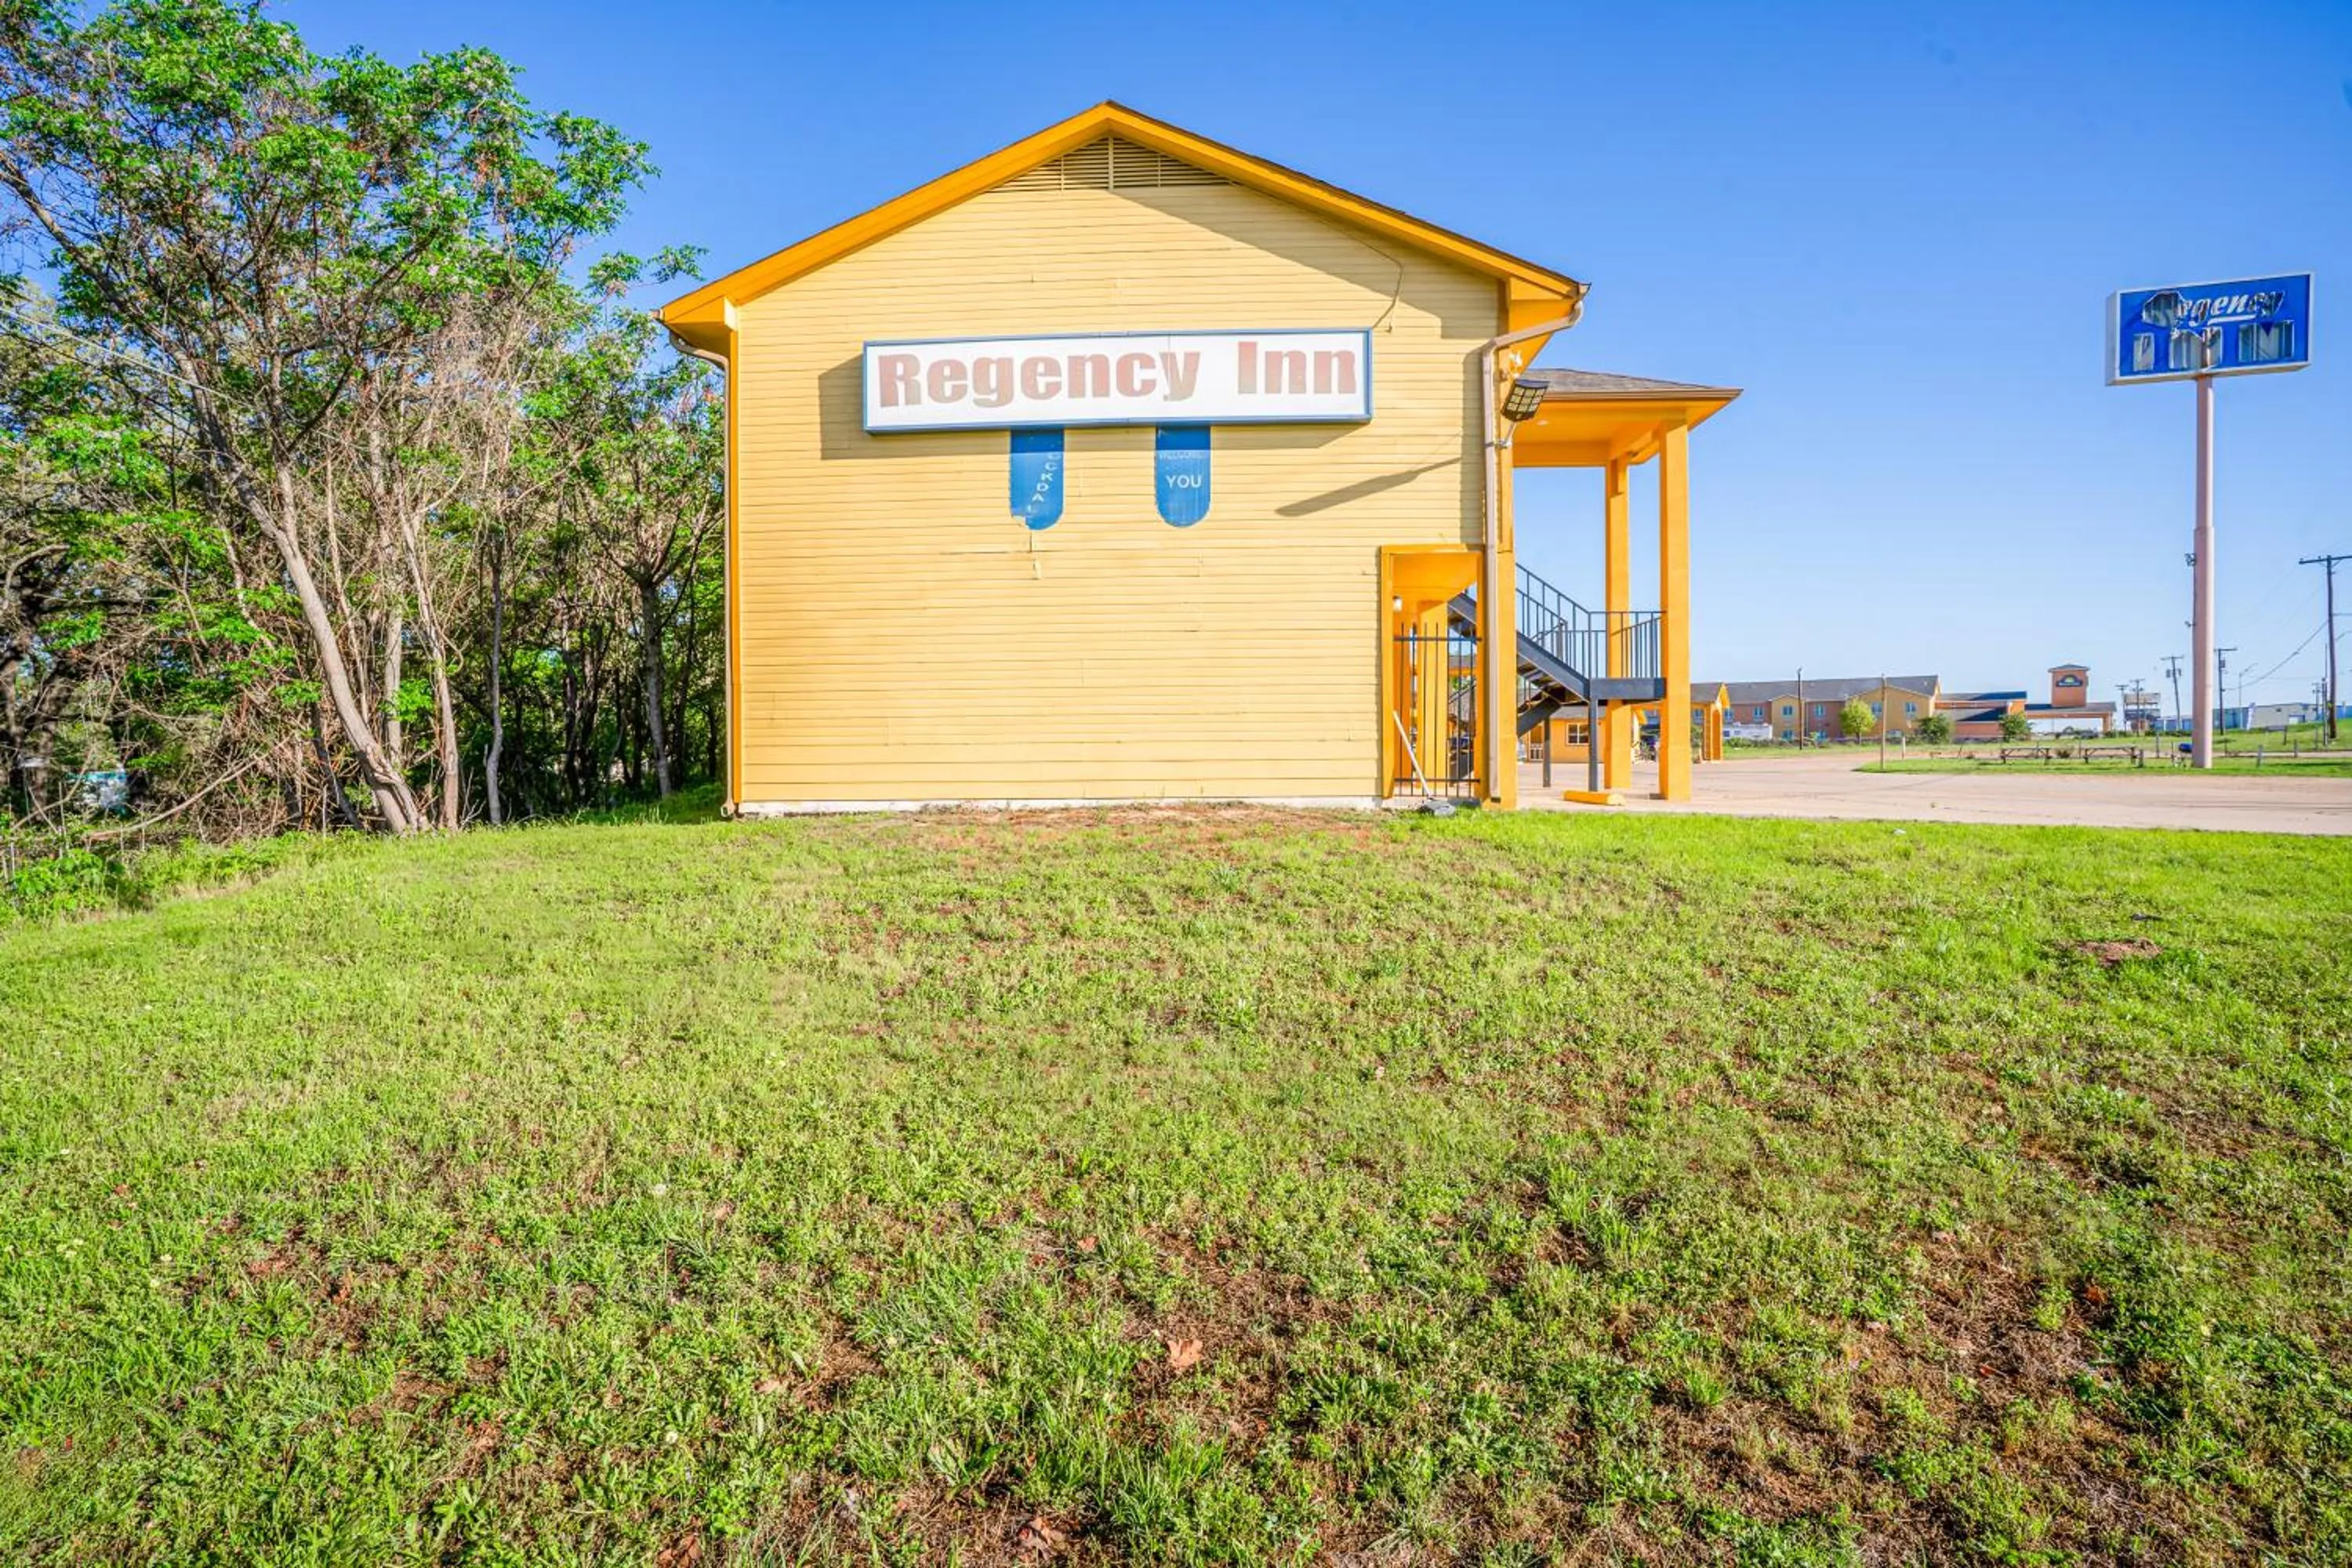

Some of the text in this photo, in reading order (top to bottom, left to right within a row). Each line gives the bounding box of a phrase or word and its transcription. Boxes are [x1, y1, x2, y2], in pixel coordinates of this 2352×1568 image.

[878, 341, 1356, 408] Regency Inn
[1165, 474, 1202, 489] YOU
